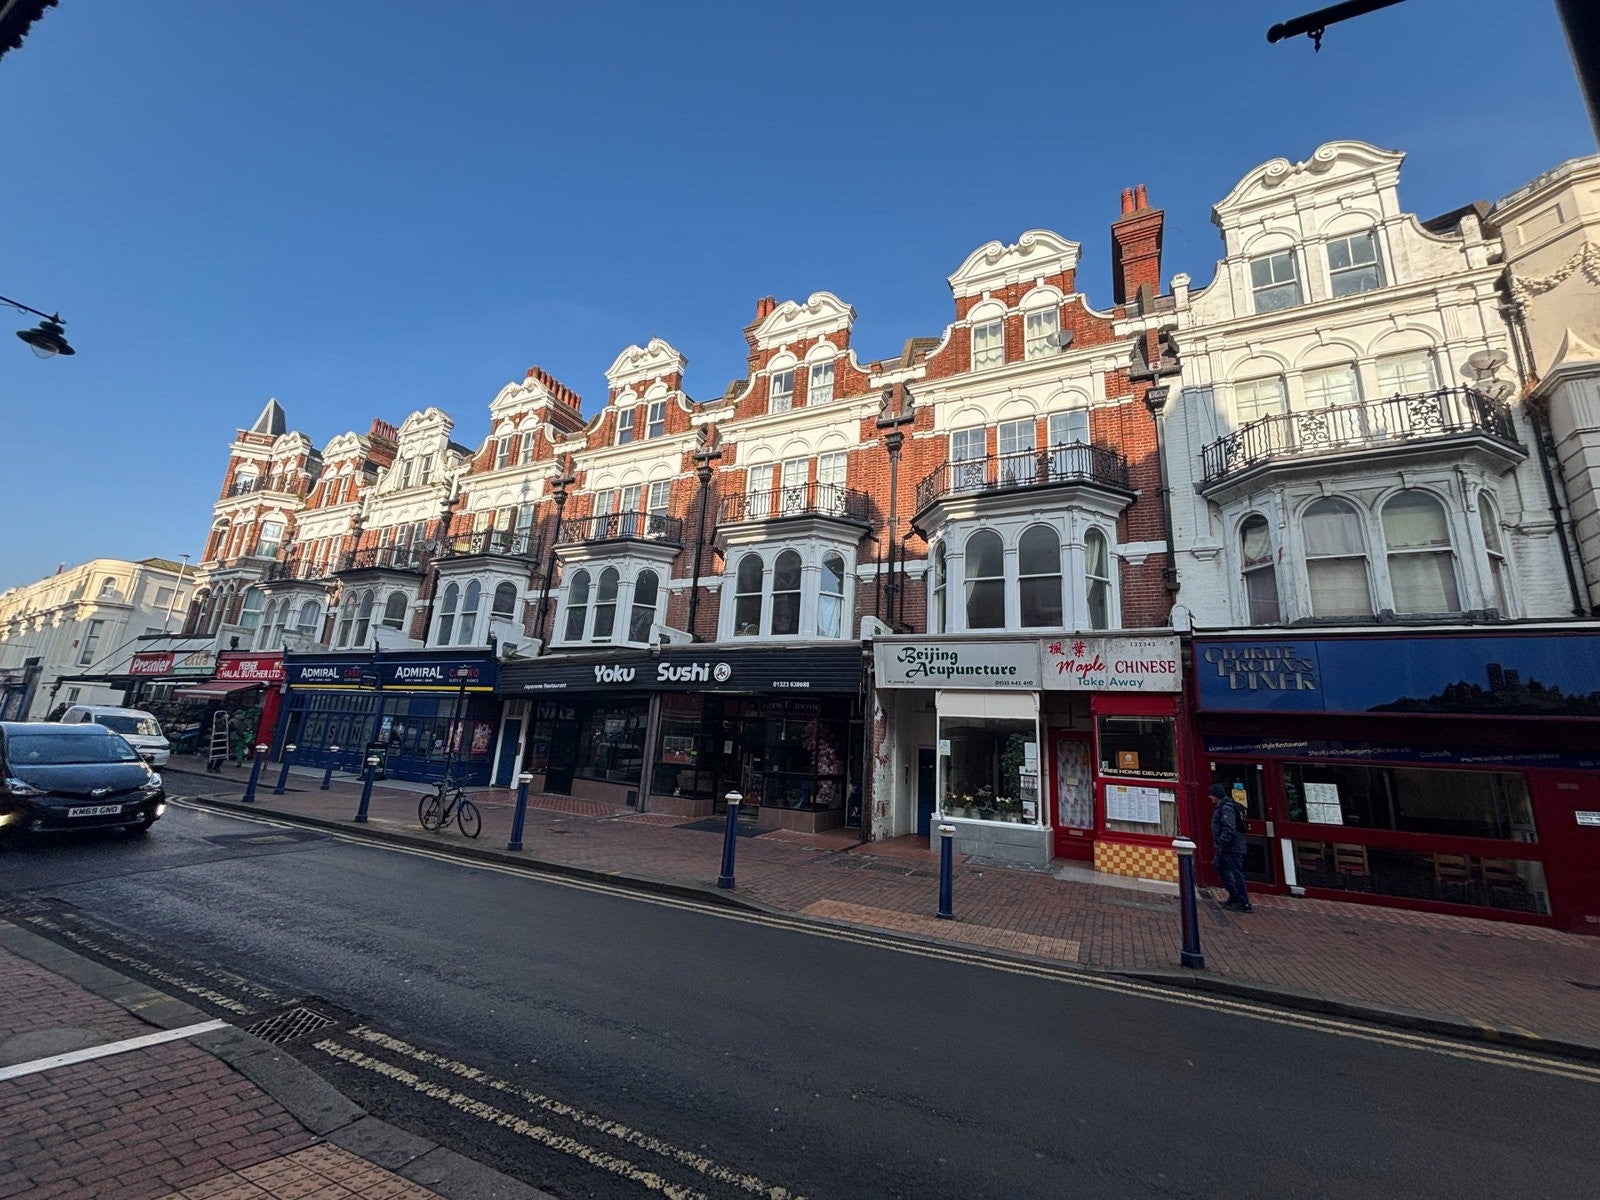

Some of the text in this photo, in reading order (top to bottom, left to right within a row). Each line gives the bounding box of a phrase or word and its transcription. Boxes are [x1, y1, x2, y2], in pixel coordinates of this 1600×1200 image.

[897, 646, 958, 665] Beijing
[1205, 646, 1296, 664] CHARLIE
[131, 657, 171, 673] Premier
[222, 668, 281, 678] HALAL BUTCHER LTD
[300, 666, 340, 679] ADMIRAL
[394, 665, 444, 679] ADMIRAL
[594, 664, 636, 683] Yoku
[656, 662, 710, 682] Sushi
[905, 662, 1017, 679] Acupuncture
[1056, 654, 1177, 679] Maple CHINESE
[1076, 676, 1144, 688] Take Away
[1229, 672, 1317, 690] DINER
[72, 807, 98, 816] KM69
